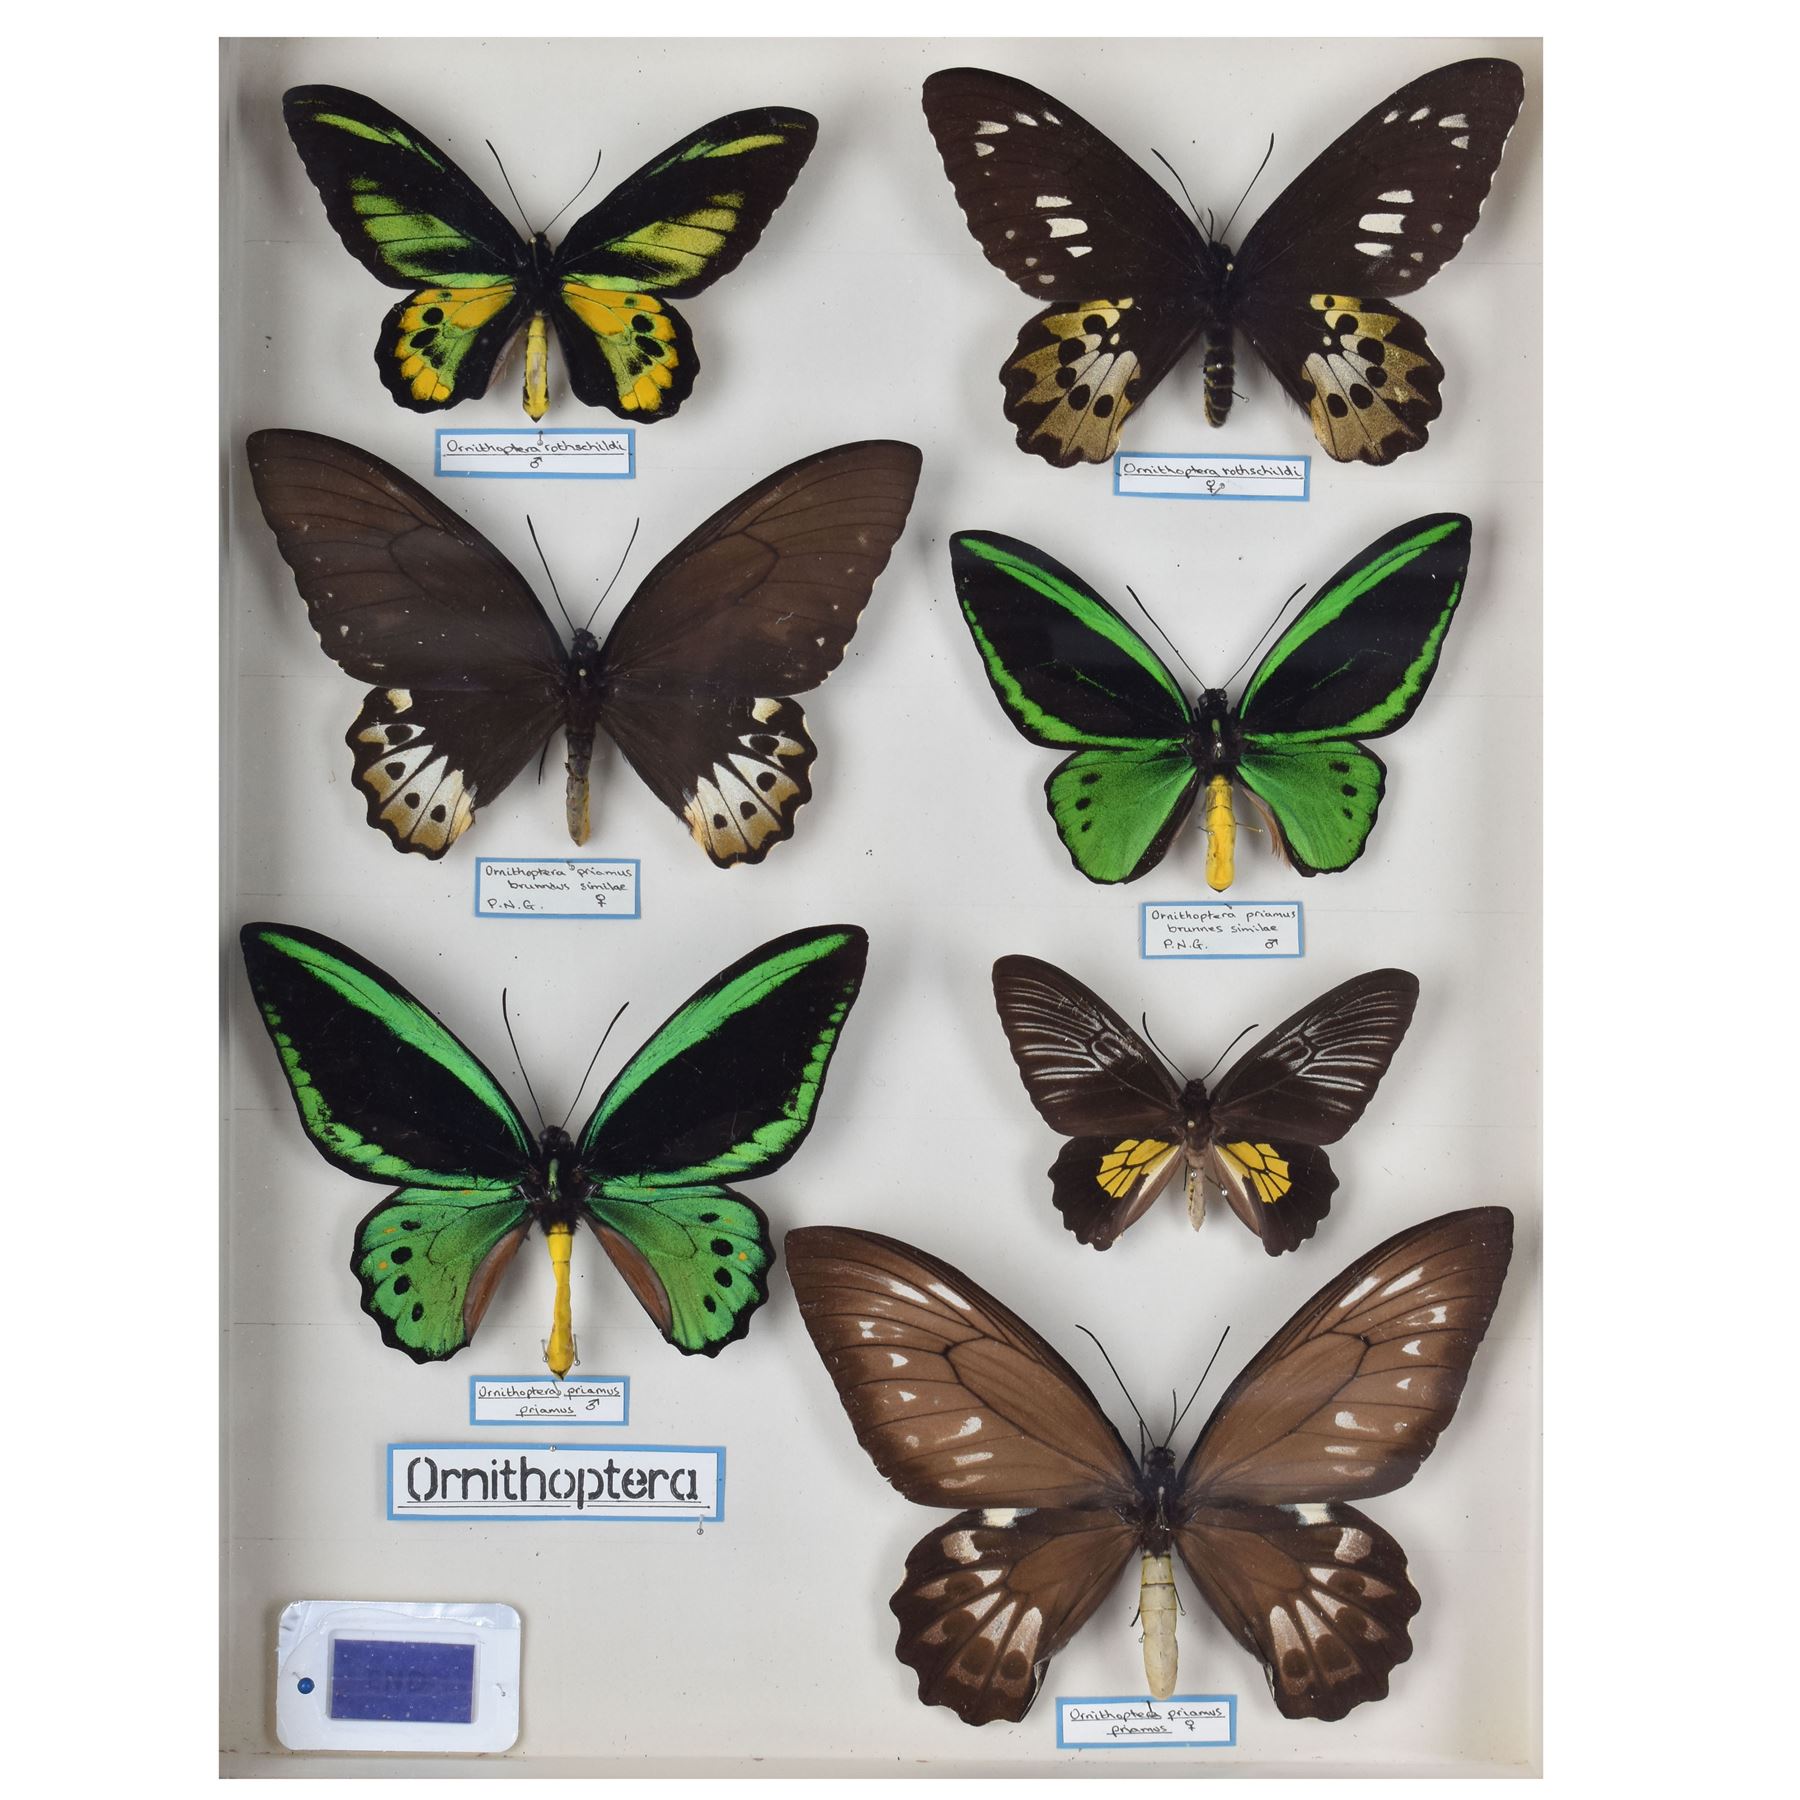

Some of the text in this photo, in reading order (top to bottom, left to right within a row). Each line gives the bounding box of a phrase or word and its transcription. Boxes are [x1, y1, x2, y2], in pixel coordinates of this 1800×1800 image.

[447, 440, 627, 455] Ornithoptera rothschildi
[1123, 463, 1302, 478] Ornithoptera rothschildi
[485, 865, 633, 880] Ornithoptera priamus
[1151, 909, 1296, 923] Ornithoptera priamus
[1167, 923, 1279, 933] brunnes similae
[478, 1386, 621, 1400] Ornithoptera priamus
[519, 1404, 575, 1417] priamus
[407, 1455, 699, 1510] Ornithoptera
[1069, 1707, 1223, 1722] Ornithoptera priamus
[1111, 1724, 1168, 1737] priamus
